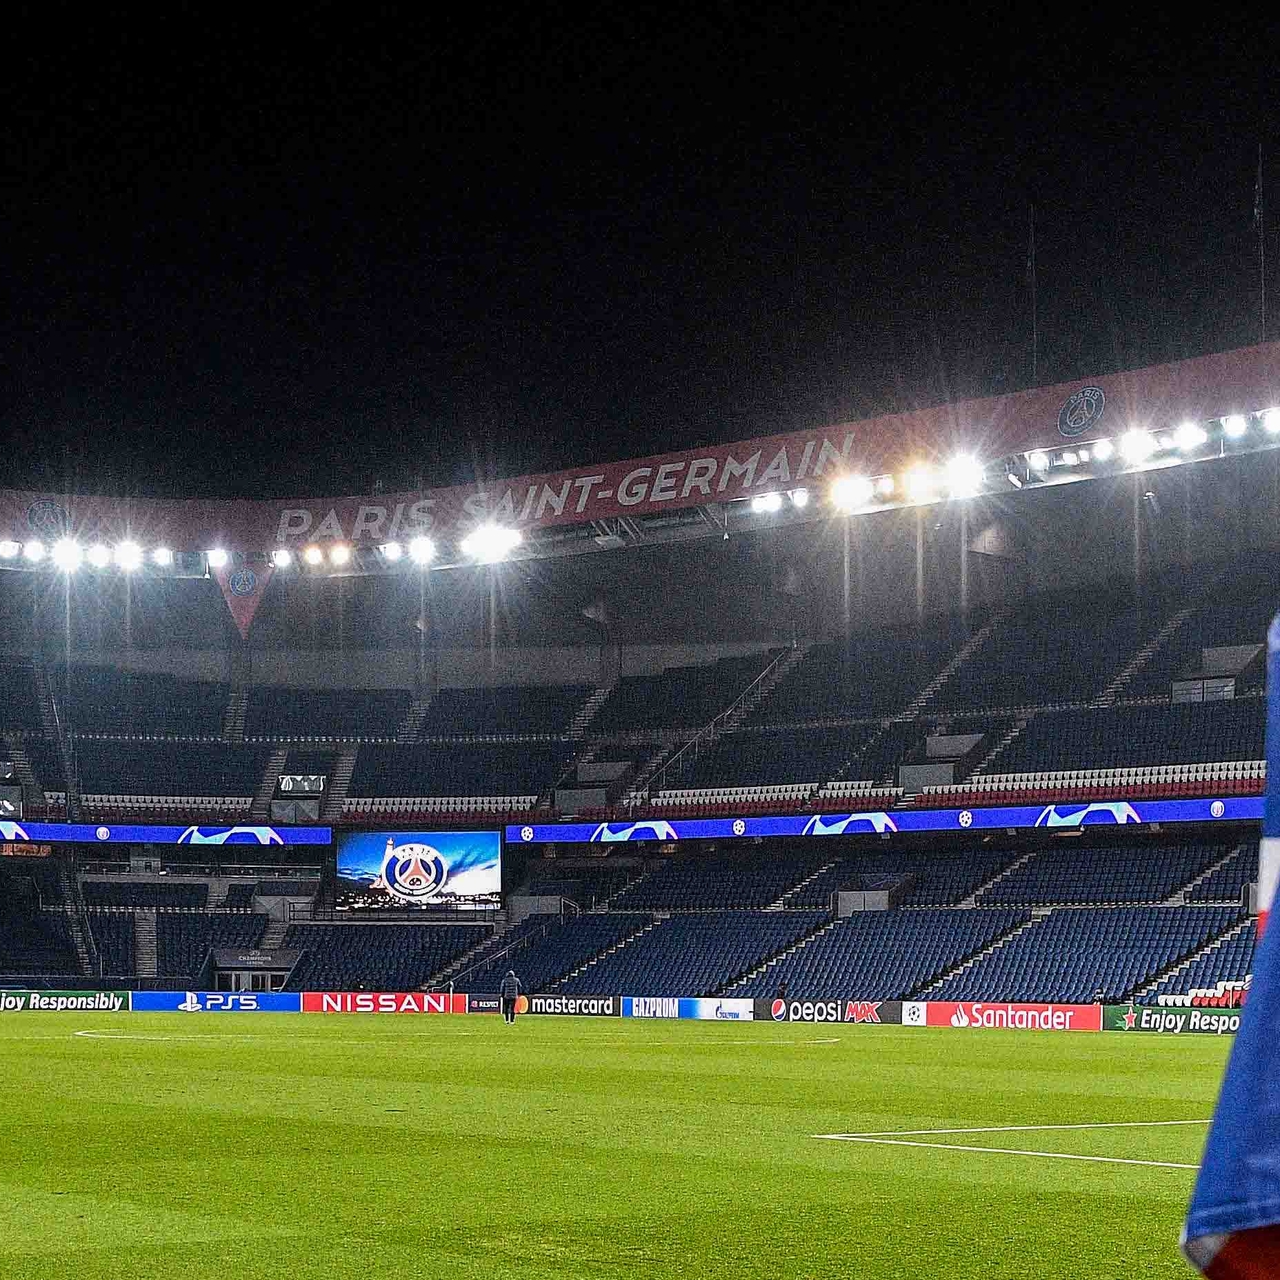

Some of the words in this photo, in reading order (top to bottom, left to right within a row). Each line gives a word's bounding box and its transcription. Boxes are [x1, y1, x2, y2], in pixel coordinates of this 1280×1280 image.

[275, 500, 436, 542] PARIS
[464, 433, 856, 521] SAINT-GERMAIN
[30, 992, 123, 1012] Responsibly
[322, 994, 445, 1013] NISSAN
[532, 996, 613, 1015] mastercard
[632, 998, 679, 1018] GAZPROM
[789, 1000, 842, 1022] pepsi
[844, 1001, 882, 1023] MAX
[971, 1003, 1074, 1030] Santander
[1141, 1008, 1187, 1033] Enjoy
